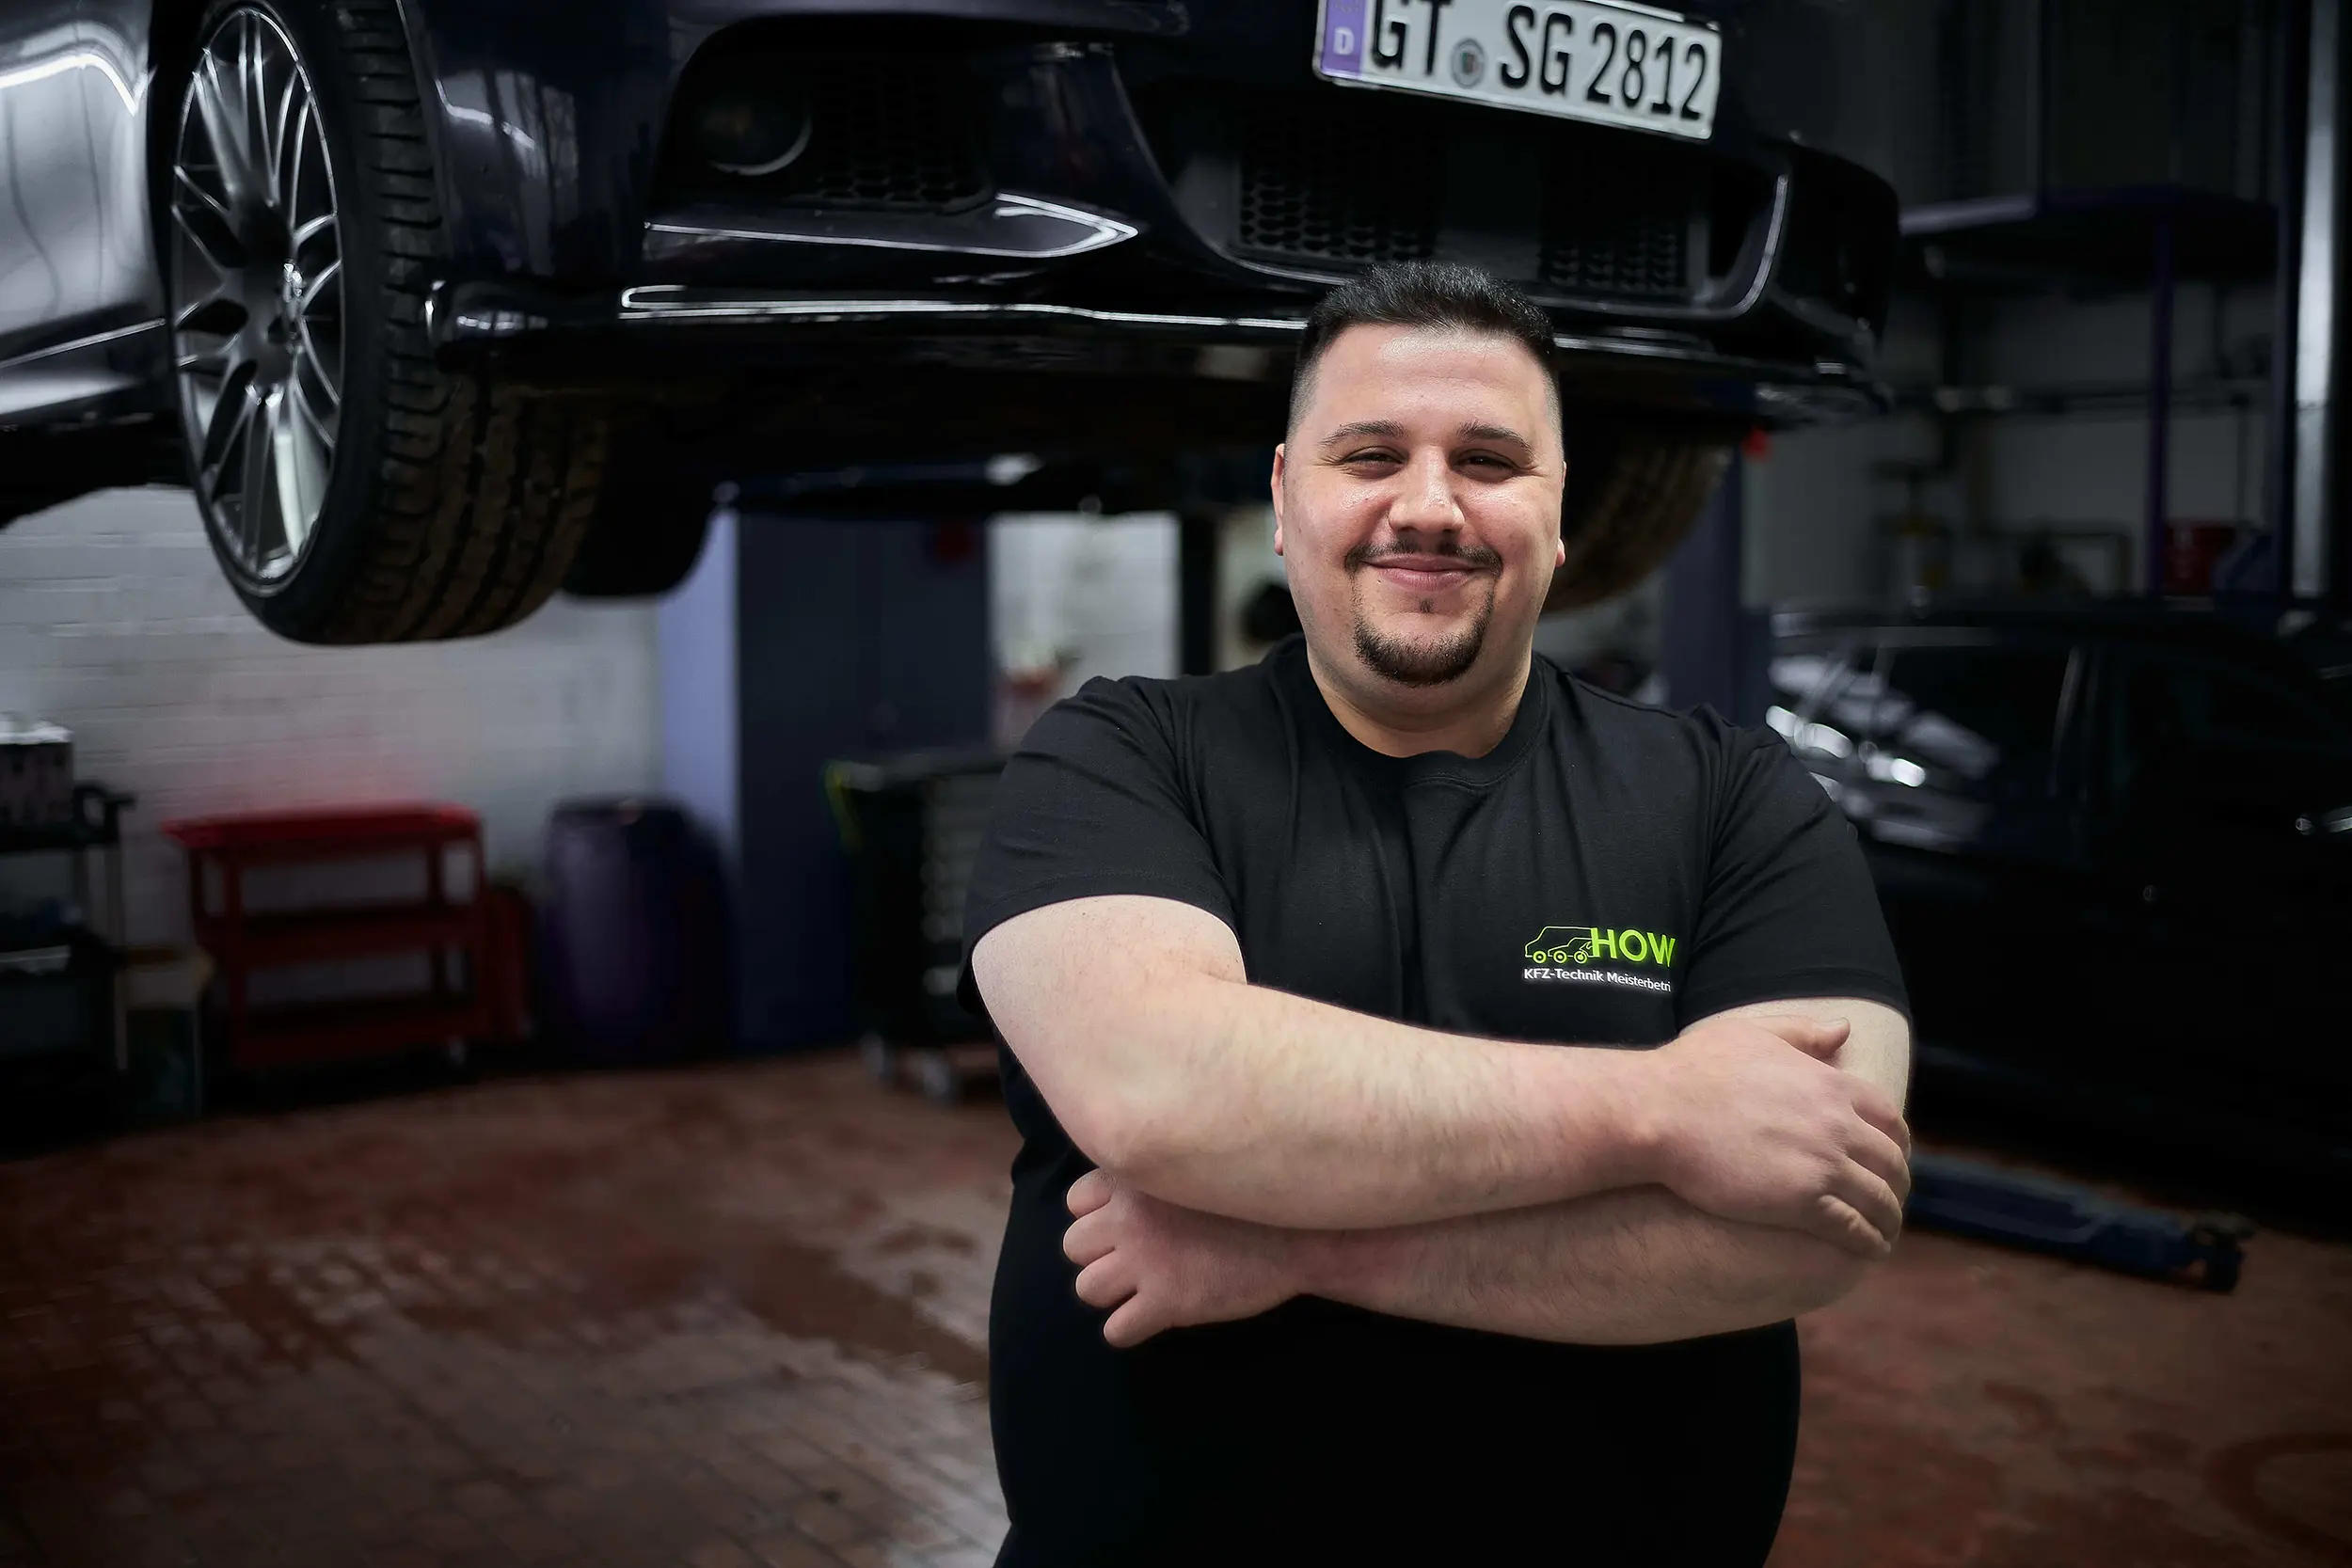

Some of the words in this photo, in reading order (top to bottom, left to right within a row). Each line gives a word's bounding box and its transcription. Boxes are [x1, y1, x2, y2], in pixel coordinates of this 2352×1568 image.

[1333, 26, 1355, 56] D
[1372, 0, 1454, 76] GT
[1500, 5, 1573, 95] SG
[1585, 22, 1708, 120] 2812
[1590, 927, 1677, 967] HOW
[1523, 967, 1605, 983] KFZ-Technik
